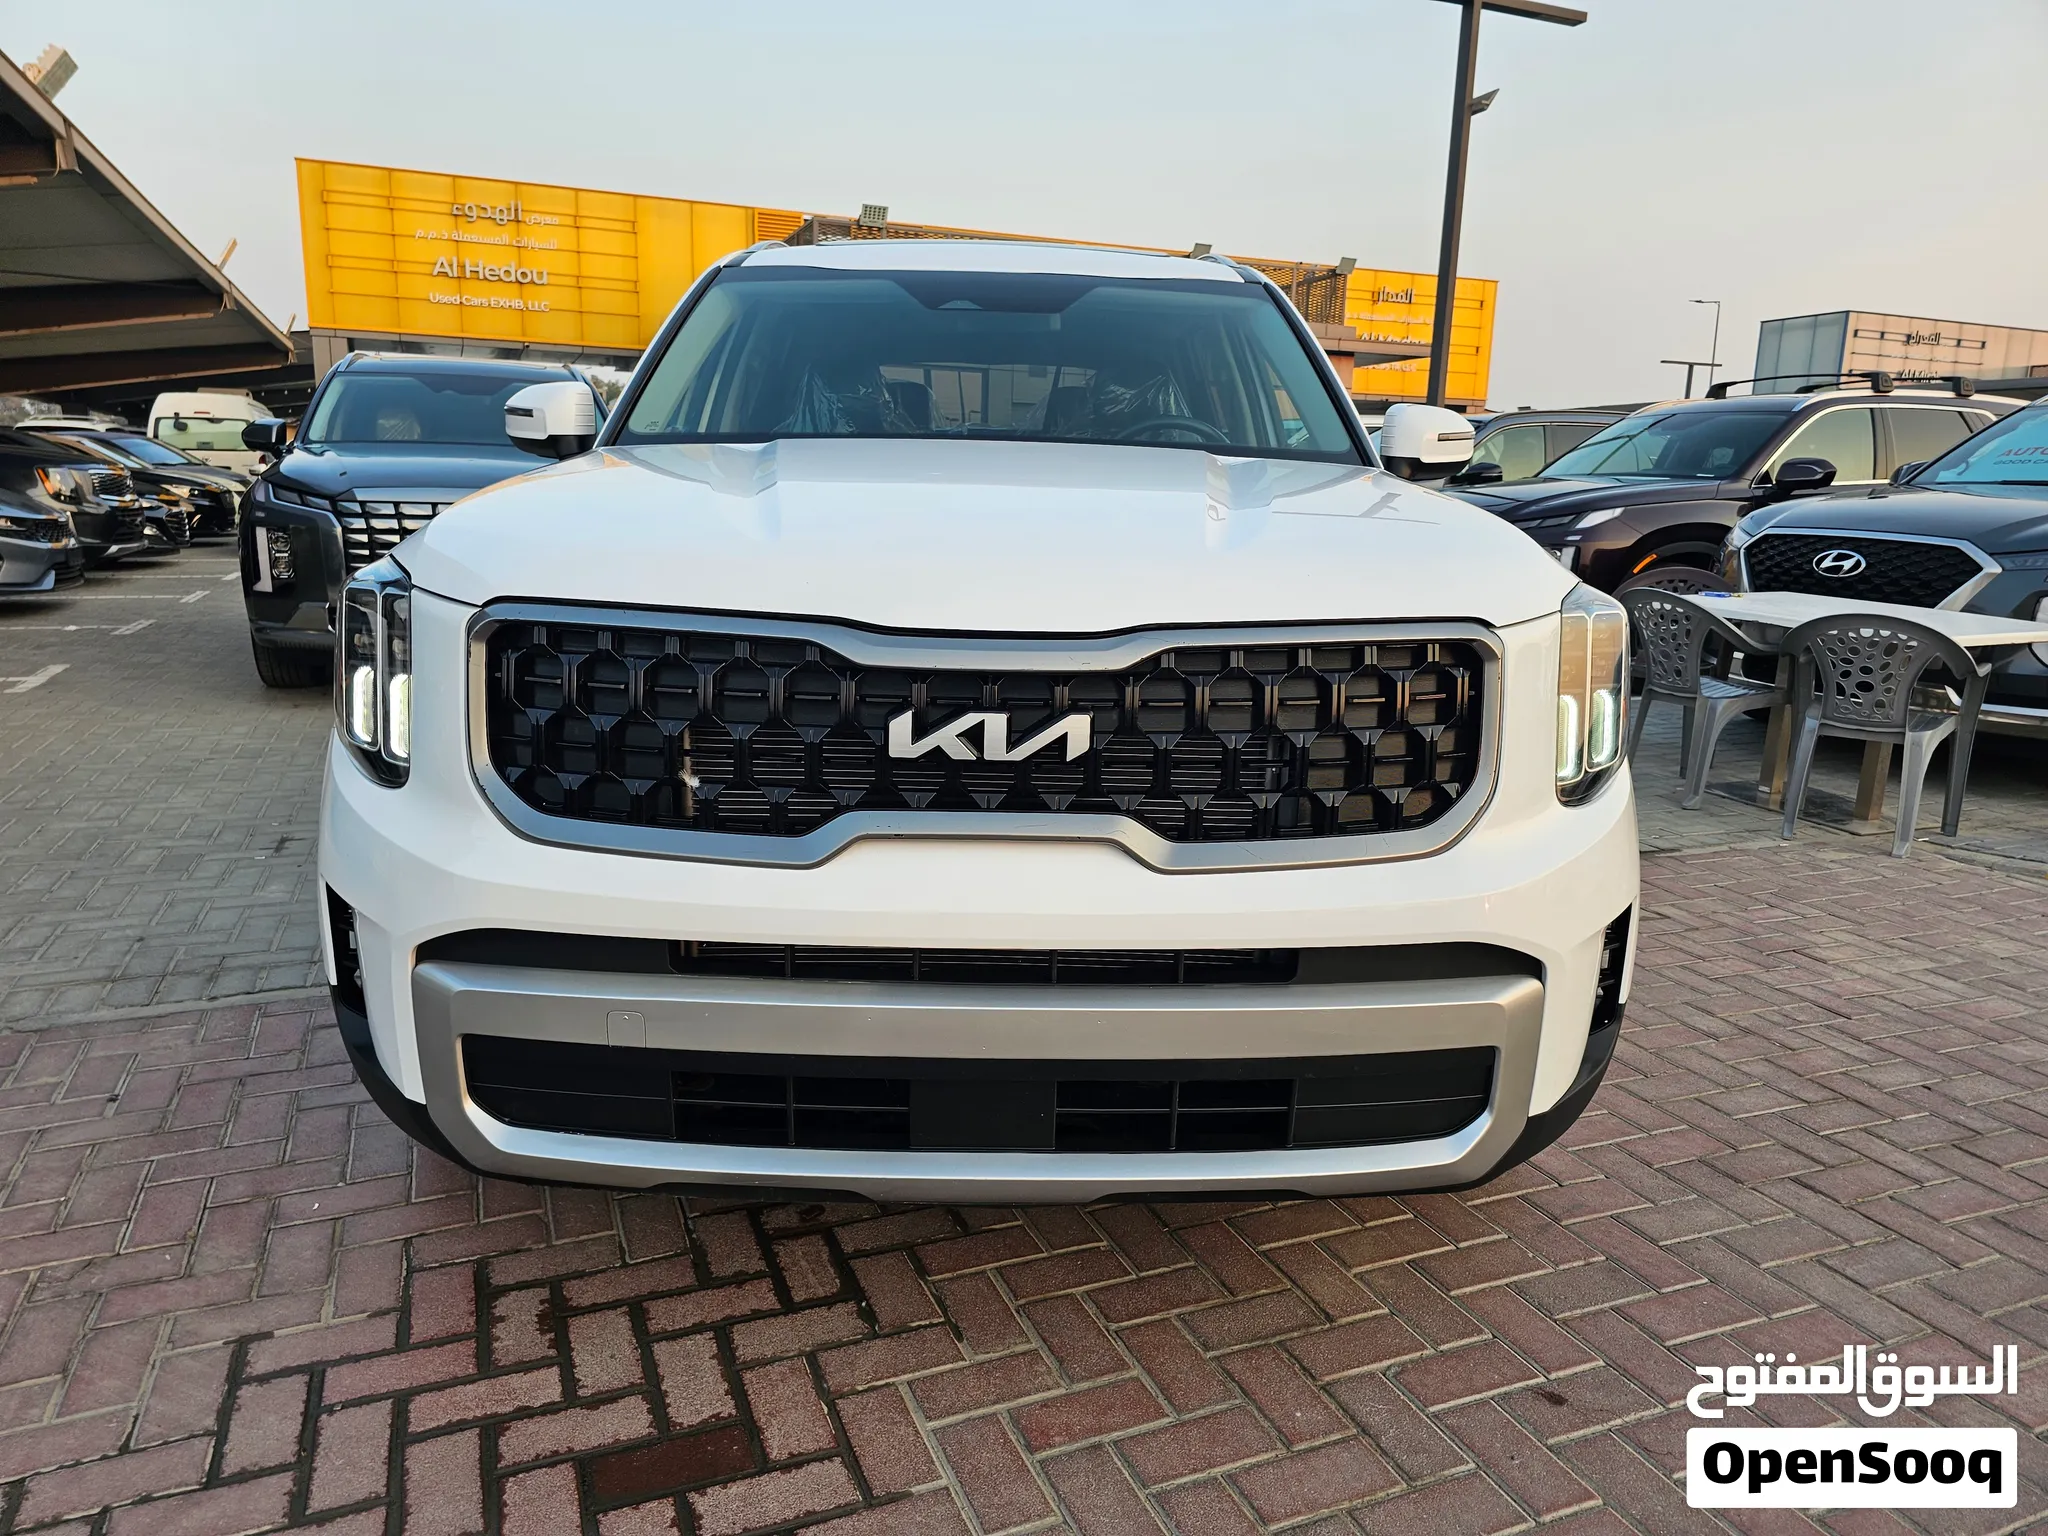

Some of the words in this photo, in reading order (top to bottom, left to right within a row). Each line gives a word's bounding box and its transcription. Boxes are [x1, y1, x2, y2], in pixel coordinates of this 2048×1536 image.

[451, 199, 522, 225] الهدوء
[451, 229, 509, 246] المستعملة
[432, 256, 458, 278] Al
[465, 258, 548, 285] Hedou
[429, 291, 460, 305] Used
[462, 295, 489, 308] Cars
[528, 300, 550, 312] LLC
[889, 708, 1092, 763] KIA
